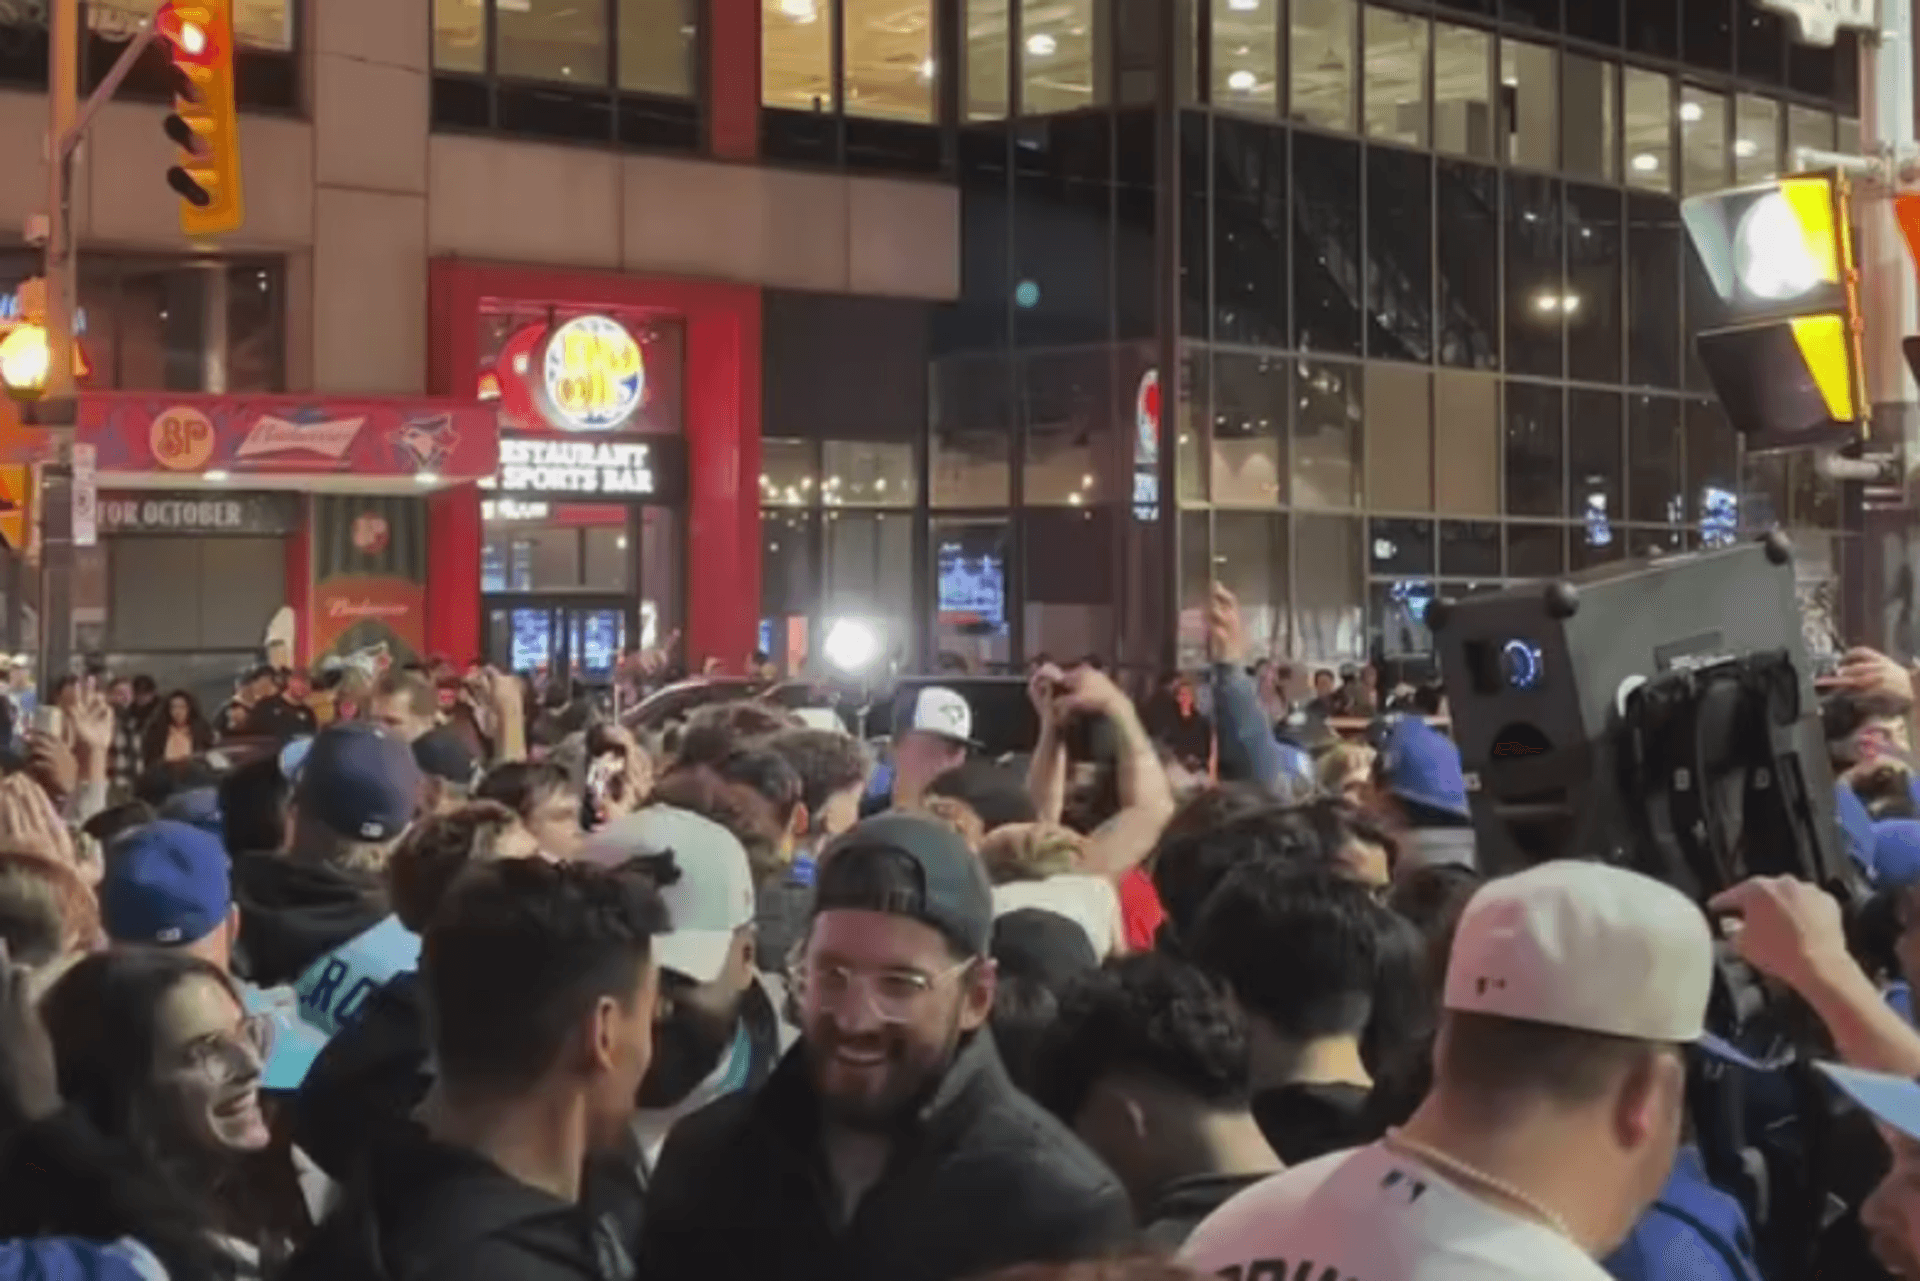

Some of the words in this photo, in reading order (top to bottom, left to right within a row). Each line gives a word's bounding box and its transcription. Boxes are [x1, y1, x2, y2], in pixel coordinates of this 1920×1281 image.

[503, 466, 597, 491] SPORTS
[602, 468, 653, 493] BAR
[143, 500, 241, 526] OCTOBER
